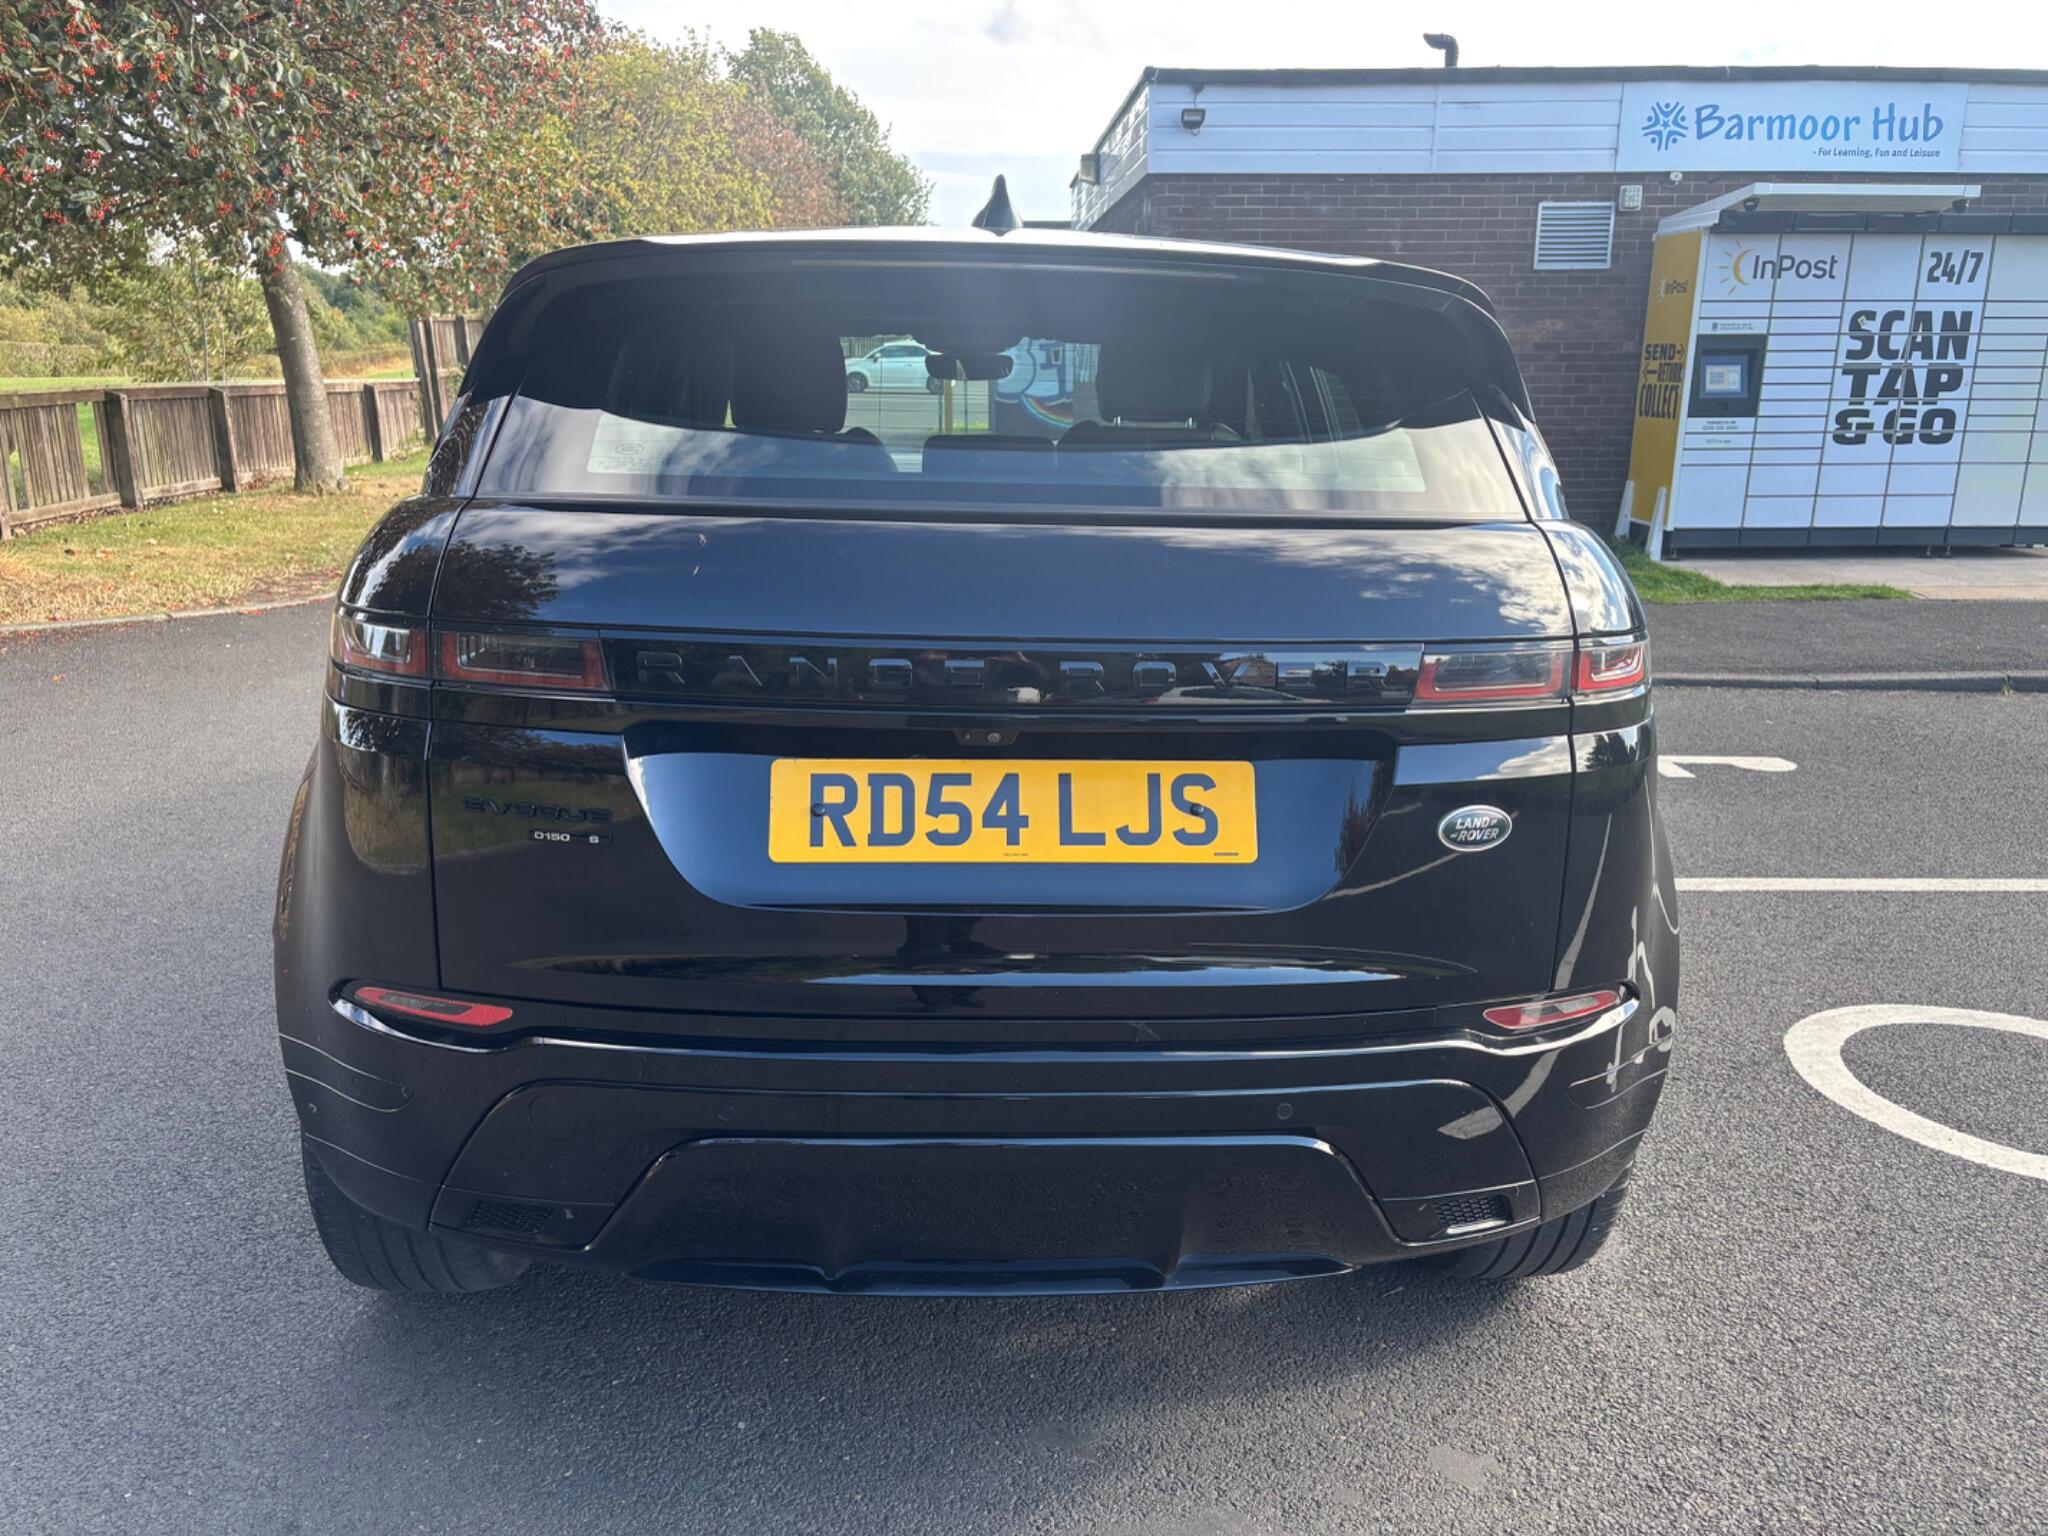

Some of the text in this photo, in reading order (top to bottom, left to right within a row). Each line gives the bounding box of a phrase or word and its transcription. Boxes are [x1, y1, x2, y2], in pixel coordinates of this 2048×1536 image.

[1694, 102, 1944, 142] Barmoor Hub
[1818, 147, 1831, 156] For
[1833, 147, 1873, 158] Learning,
[1875, 147, 1890, 157] Fun
[1891, 147, 1908, 157] and
[1909, 147, 1941, 157] Leisure
[1752, 254, 1838, 280] InPost
[1926, 249, 1984, 285] 24/7
[1664, 280, 1688, 294] InPost
[1643, 343, 1677, 361] SEND
[1845, 309, 1973, 361] SCAN
[1638, 383, 1680, 419] COLLECT
[1842, 362, 1964, 406] TAP
[1832, 408, 1957, 445] & GO
[636, 650, 1389, 692] RANGE ROVER
[462, 795, 614, 824] EVOQUE
[809, 772, 1219, 847] RD54 LJS
[1455, 816, 1491, 830] LAND
[1456, 827, 1499, 842] ROVER
